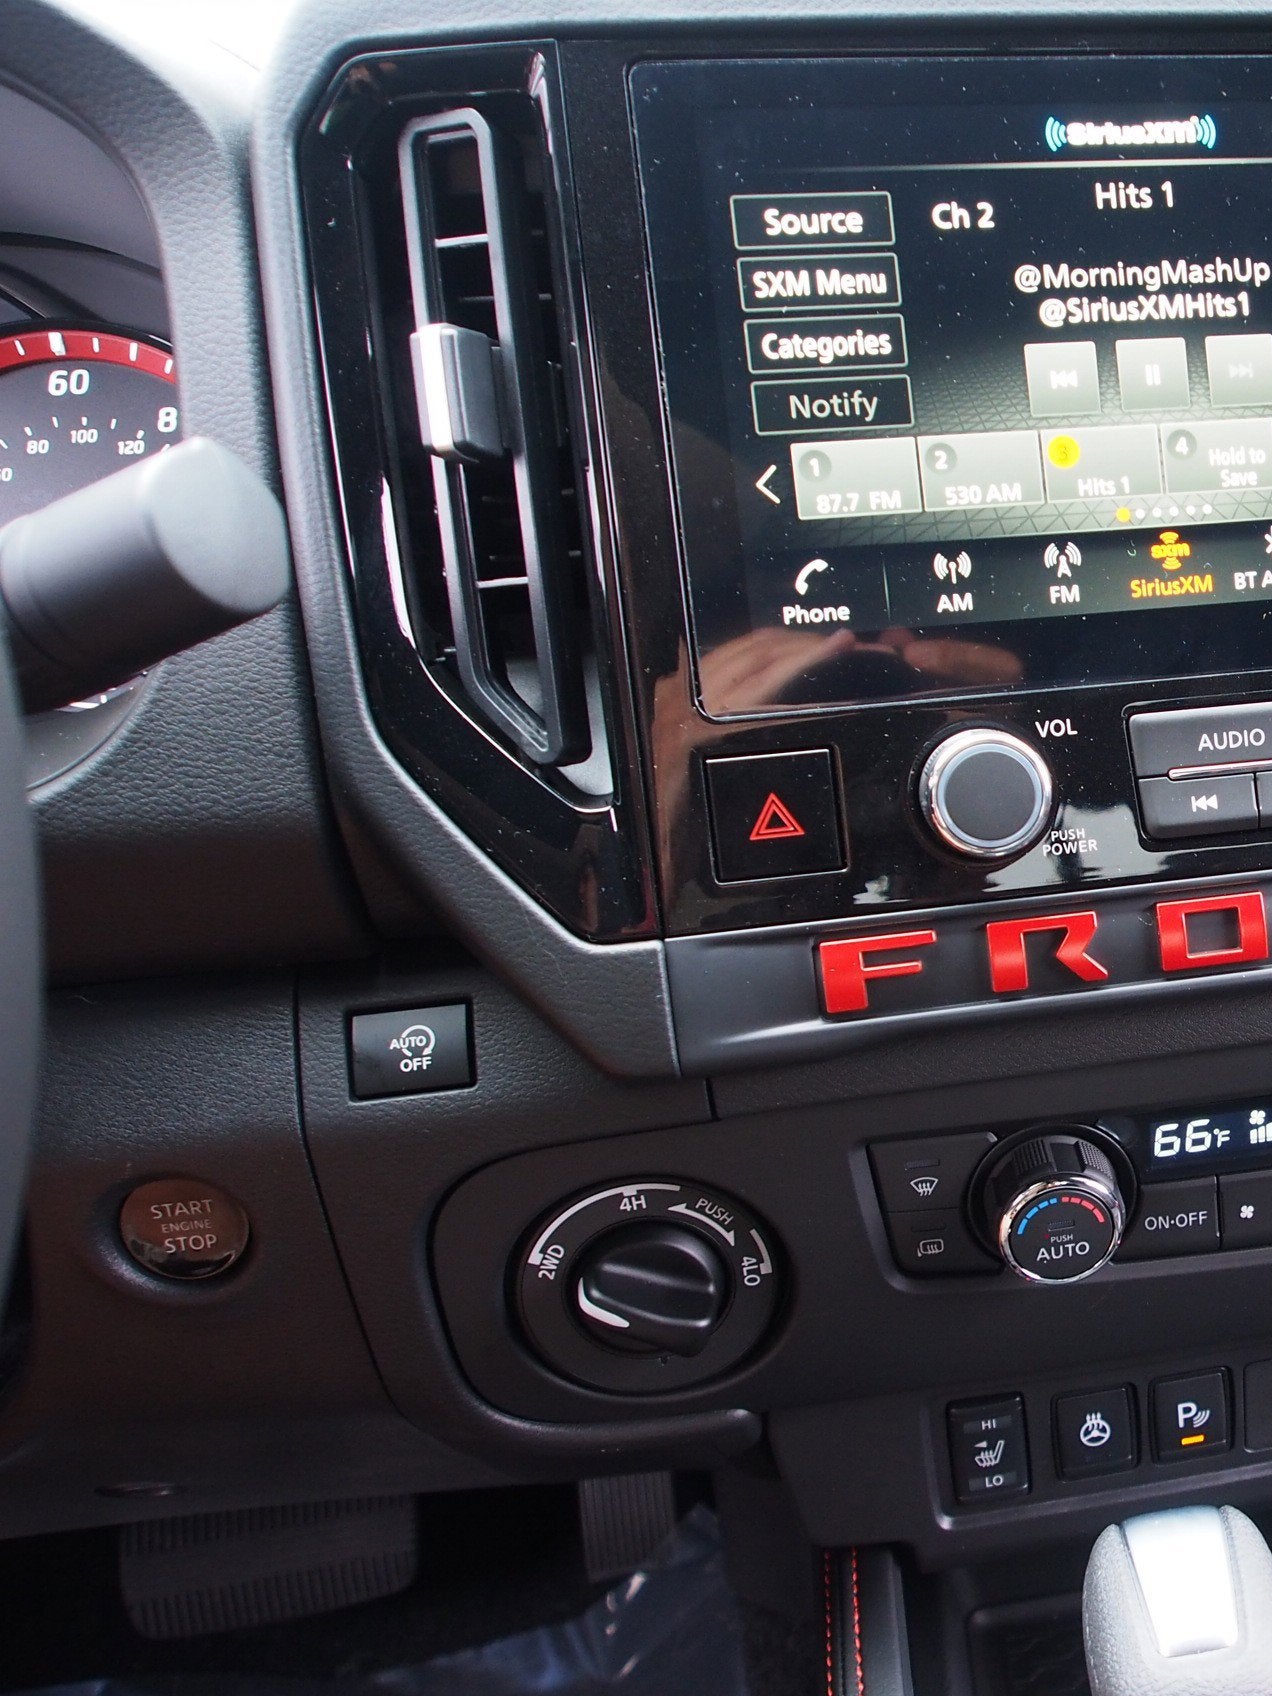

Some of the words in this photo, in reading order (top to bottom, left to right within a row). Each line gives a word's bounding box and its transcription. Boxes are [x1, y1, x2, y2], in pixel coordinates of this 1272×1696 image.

[1094, 181, 1153, 210] Hits
[1160, 181, 1176, 208] 1
[763, 206, 864, 238] Source
[931, 202, 971, 231] Ch
[976, 202, 996, 230] 2
[752, 270, 812, 298] SXM
[817, 267, 887, 297] Menu
[1014, 256, 1271, 293] @MorningMashUp
[1038, 291, 1250, 328] @SiriusXMHits1
[761, 329, 893, 365] Categories
[48, 369, 90, 396] 60
[788, 391, 880, 422] Notify
[26, 439, 50, 454] 80
[70, 429, 99, 444] 100
[1175, 437, 1189, 455] 4
[117, 439, 146, 456] 120
[1209, 446, 1246, 467] Hold
[1249, 448, 1266, 465] to
[810, 458, 821, 478] 1
[933, 451, 949, 471] 2
[0, 467, 13, 482] 0
[1220, 468, 1258, 488] Save
[945, 485, 982, 506] 530
[985, 483, 1022, 504] AM
[1077, 478, 1117, 498] Hits
[1121, 475, 1131, 495] 1
[816, 493, 860, 514] 87.7
[869, 490, 902, 512] FM
[1130, 575, 1214, 599] SiriusXM
[1233, 572, 1257, 591] BT
[936, 593, 974, 613] AM
[1049, 585, 1081, 604] FM
[782, 603, 851, 627] Phone
[1034, 718, 1079, 739] VOL
[1197, 727, 1266, 752] AUDIO
[1050, 828, 1087, 843] PUSH
[1042, 838, 1098, 858] POWER
[389, 1035, 428, 1051] AUTO
[399, 1056, 433, 1073] OFF
[150, 1198, 213, 1219] START
[619, 1194, 647, 1213] 4H
[695, 1196, 735, 1226] PUSH
[160, 1218, 213, 1234] ENGINE
[163, 1233, 218, 1255] STOP
[1049, 1232, 1074, 1243] PUSH
[1035, 1240, 1091, 1262] AUTO
[537, 1243, 566, 1281] 2WD
[741, 1255, 761, 1288] 4LO
[980, 1418, 998, 1431] HI
[985, 1474, 1004, 1488] LO
